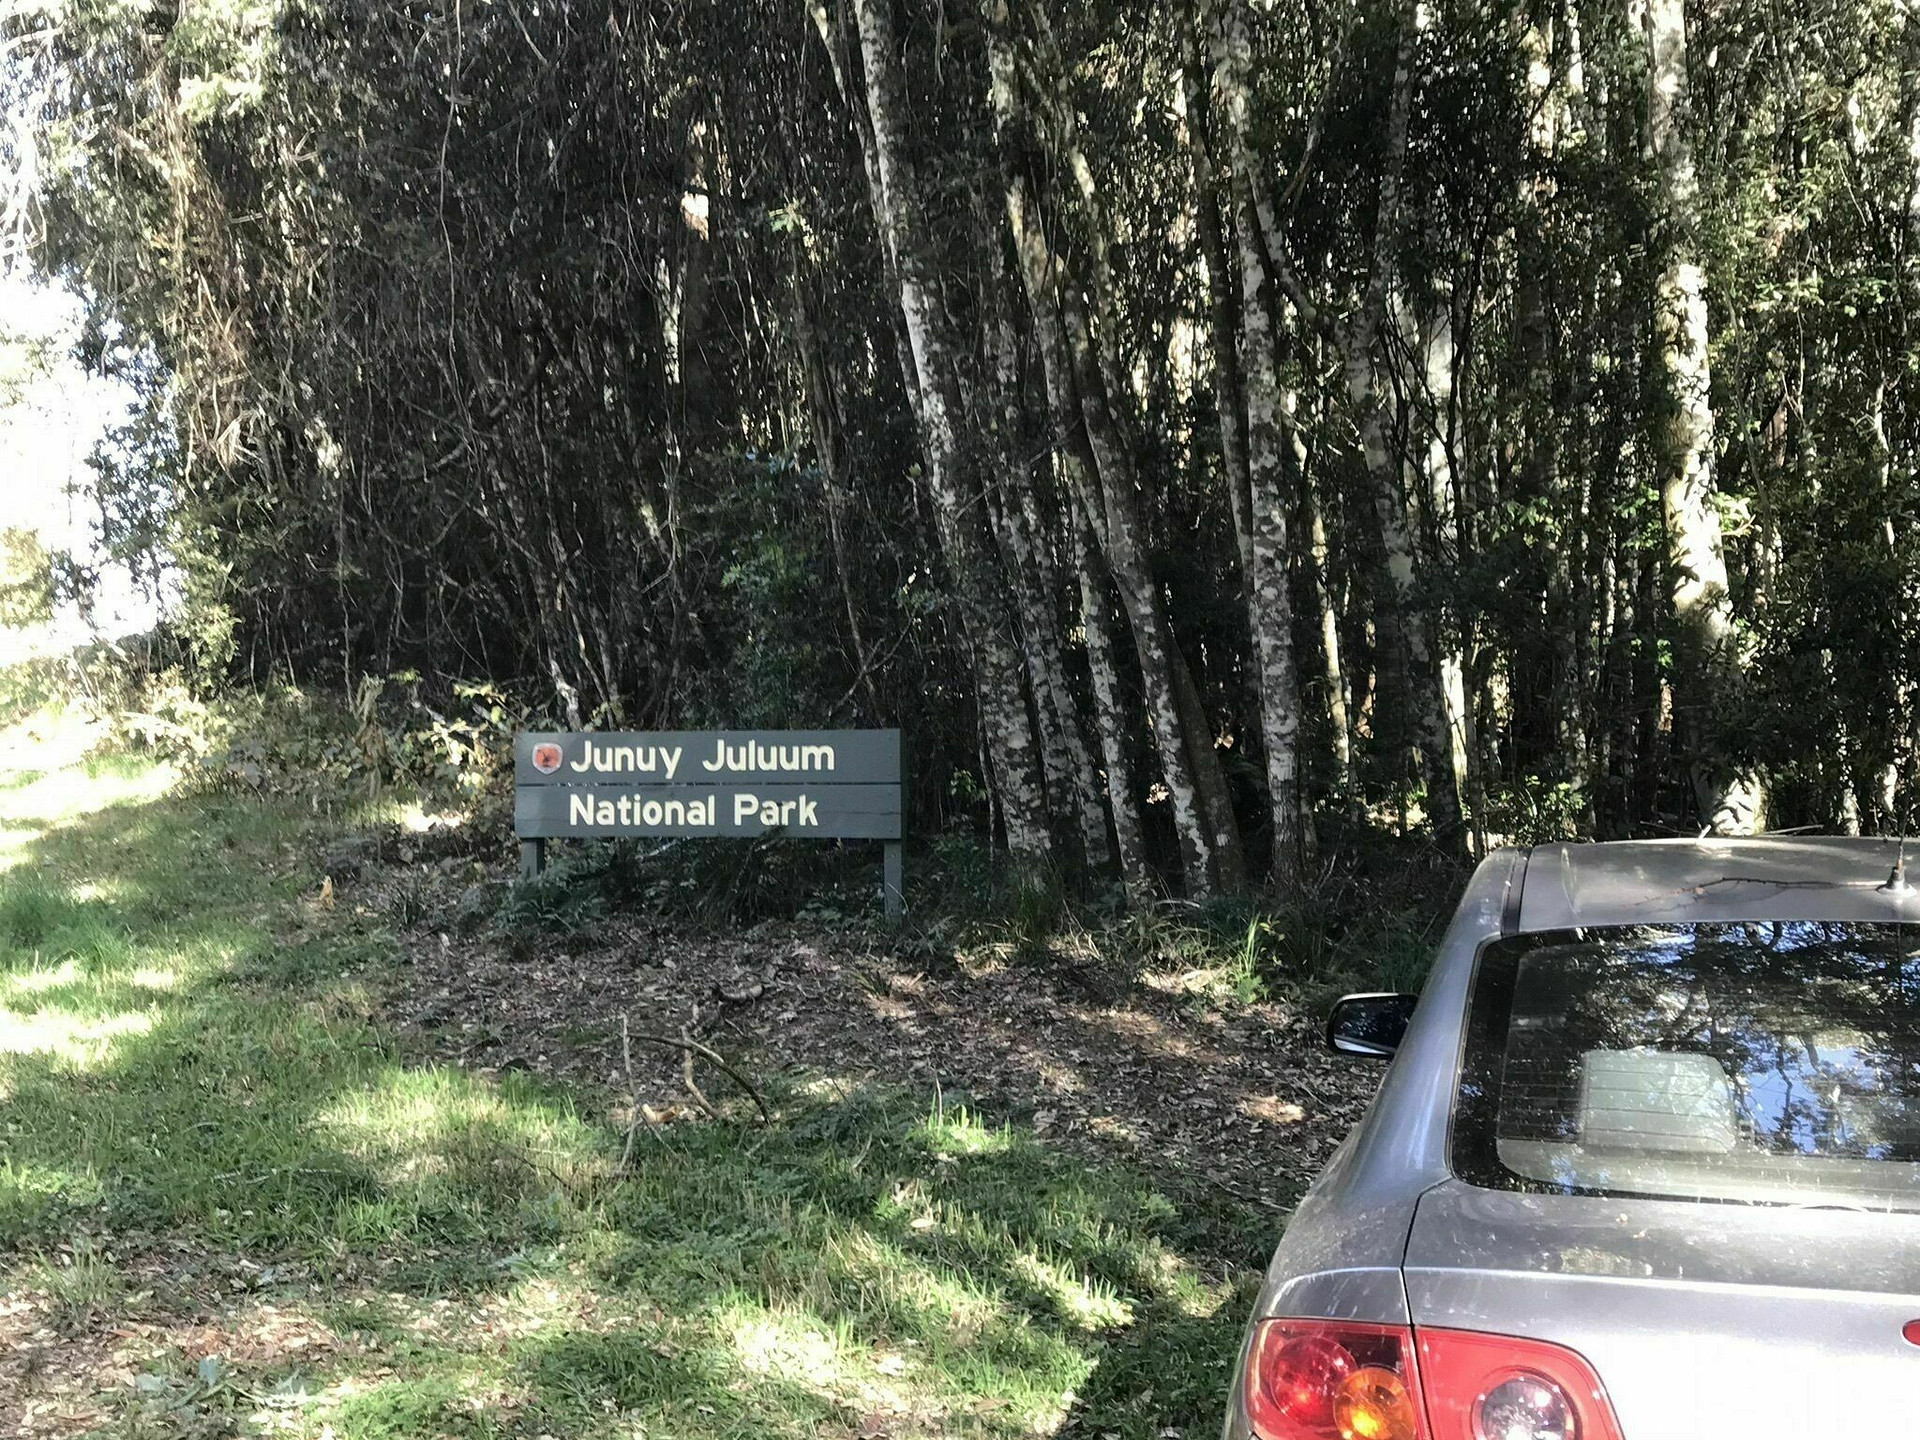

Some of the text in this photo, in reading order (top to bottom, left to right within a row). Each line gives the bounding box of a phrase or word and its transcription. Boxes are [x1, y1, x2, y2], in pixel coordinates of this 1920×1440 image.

[569, 739, 835, 780] Junuy Juluum
[569, 793, 819, 826] National Park
